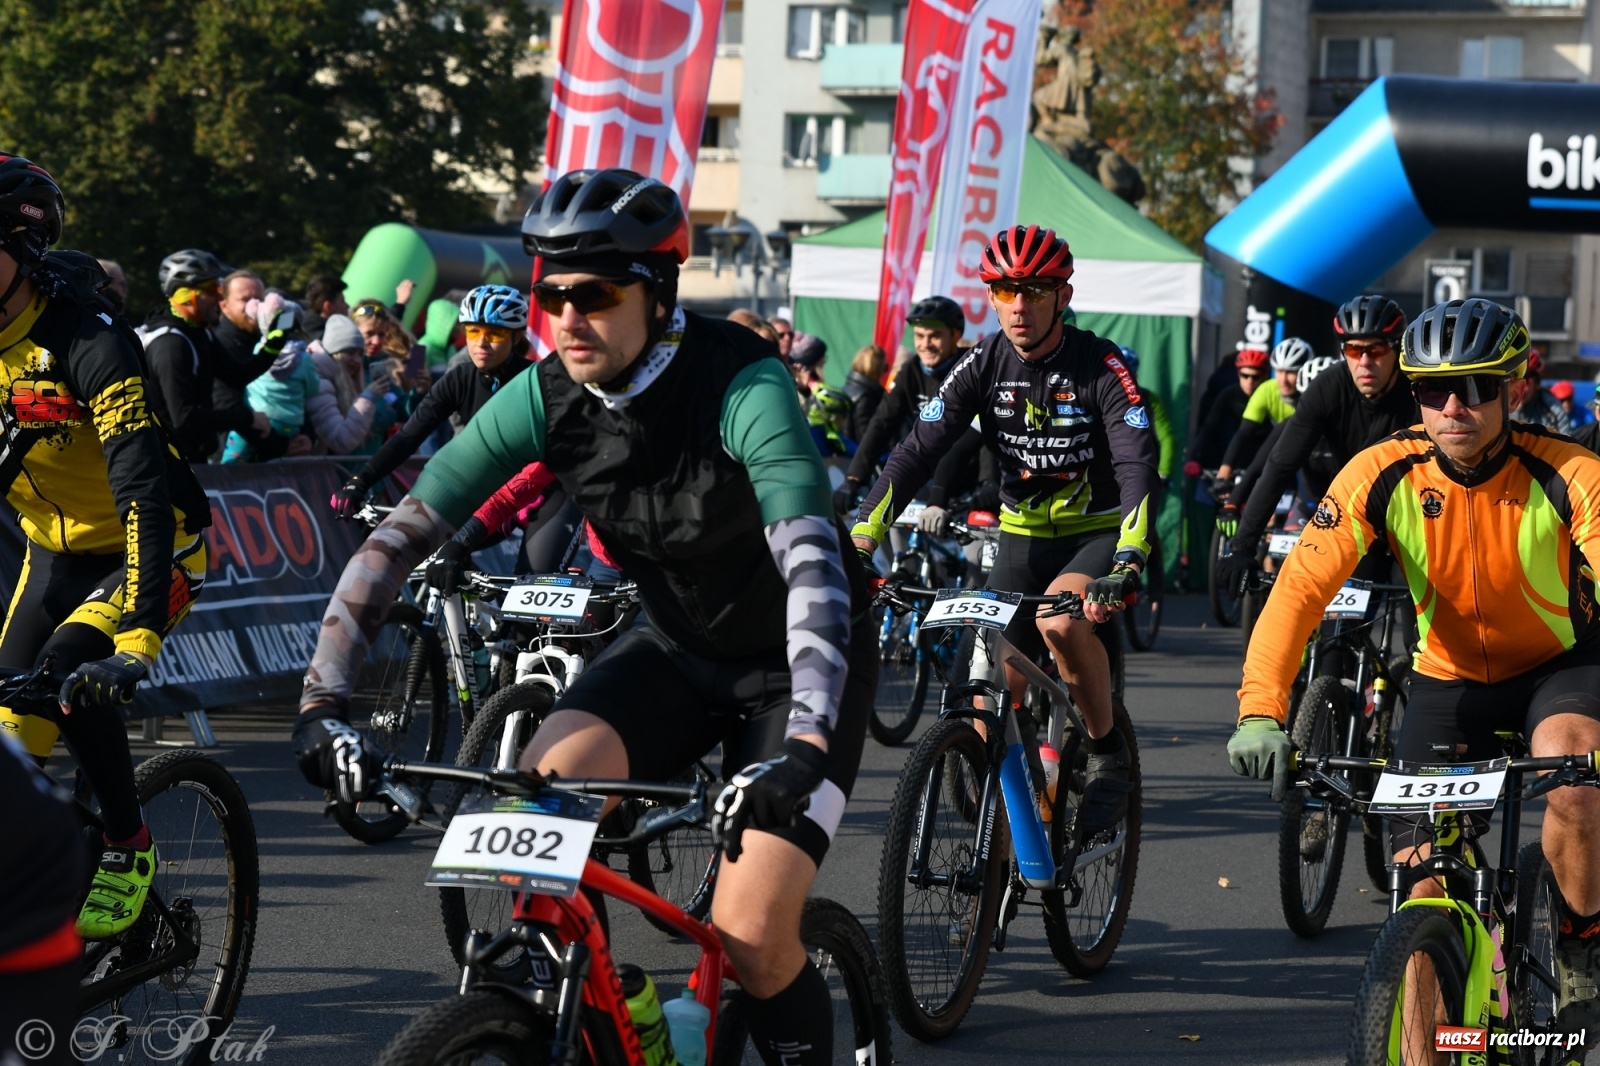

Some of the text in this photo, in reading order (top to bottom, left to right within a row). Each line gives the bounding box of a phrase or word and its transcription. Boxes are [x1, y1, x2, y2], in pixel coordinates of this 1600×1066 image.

[1498, 322, 1518, 355] SCOTT
[520, 591, 576, 609] 3075
[943, 602, 1001, 616] 1553
[1397, 781, 1480, 798] 1310
[464, 826, 564, 861] 1082
